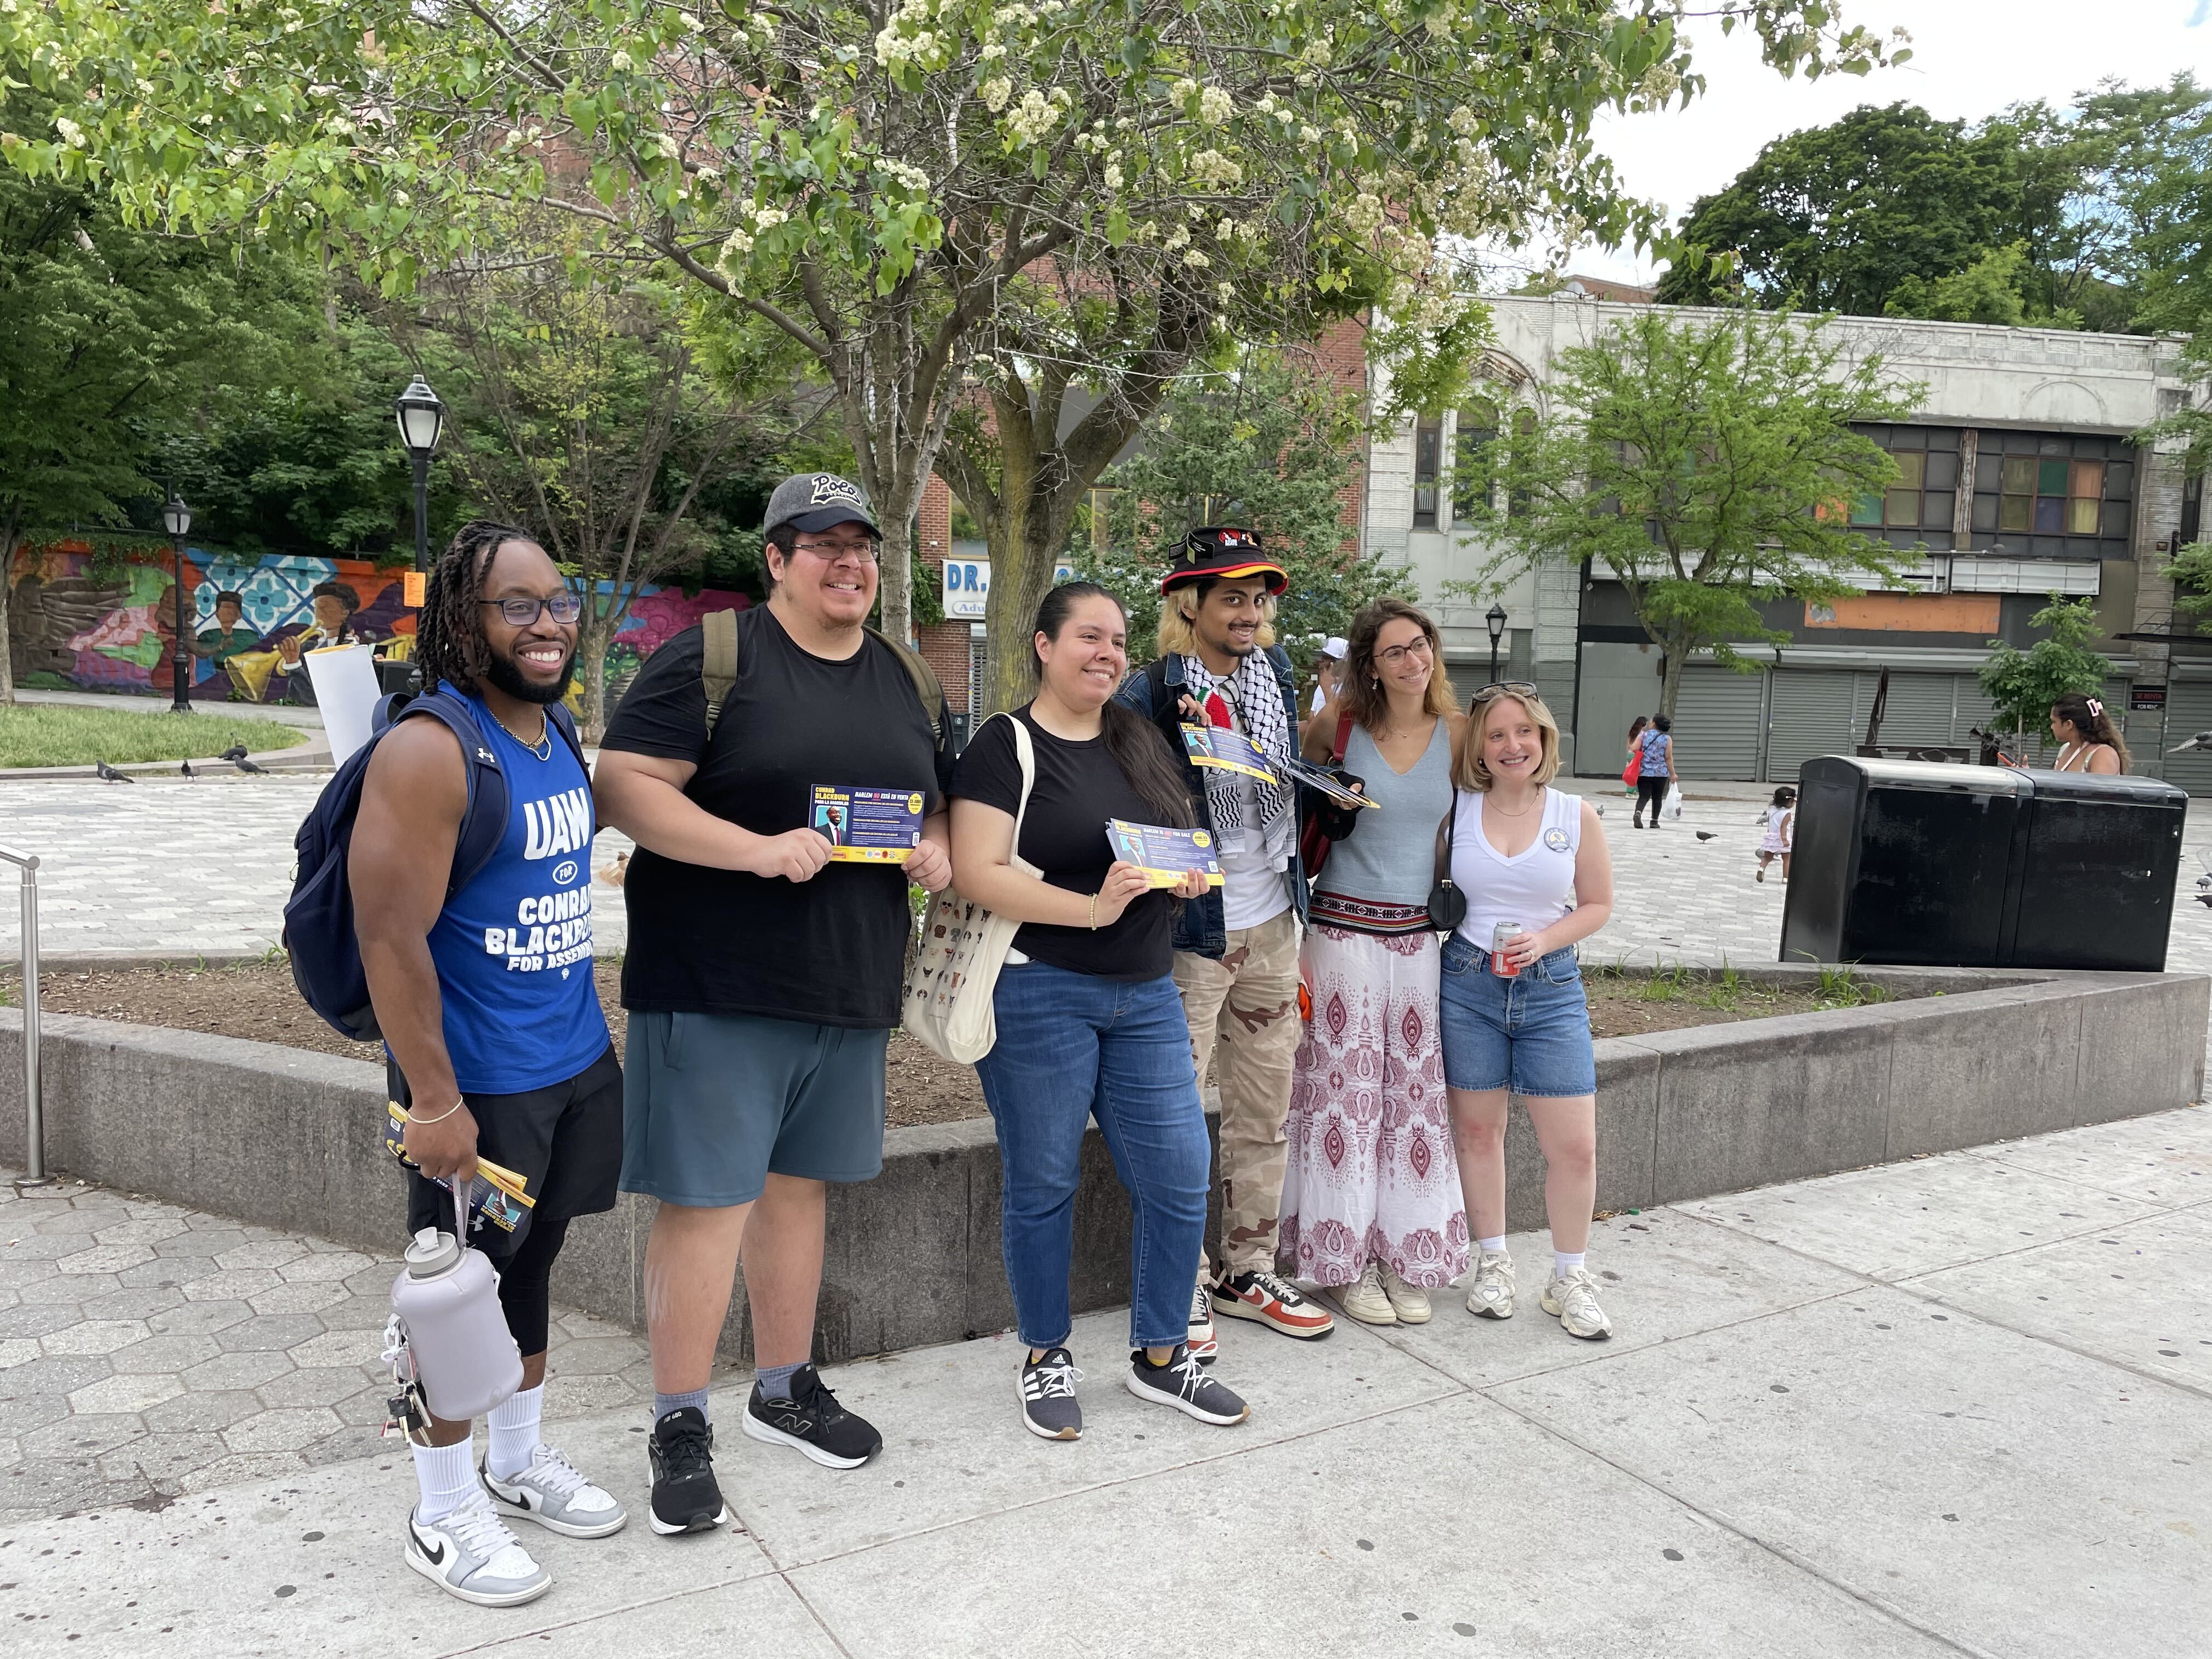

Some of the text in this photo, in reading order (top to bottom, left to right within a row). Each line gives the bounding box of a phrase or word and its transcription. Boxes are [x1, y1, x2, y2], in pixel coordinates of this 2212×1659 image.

[948, 564, 986, 591] DR.
[815, 792, 849, 801] BLACKBURN
[523, 787, 590, 860] UAW
[560, 865, 573, 881] FOR
[485, 912, 592, 955] BLACKBU
[506, 936, 593, 972] FOR ASSEMB
